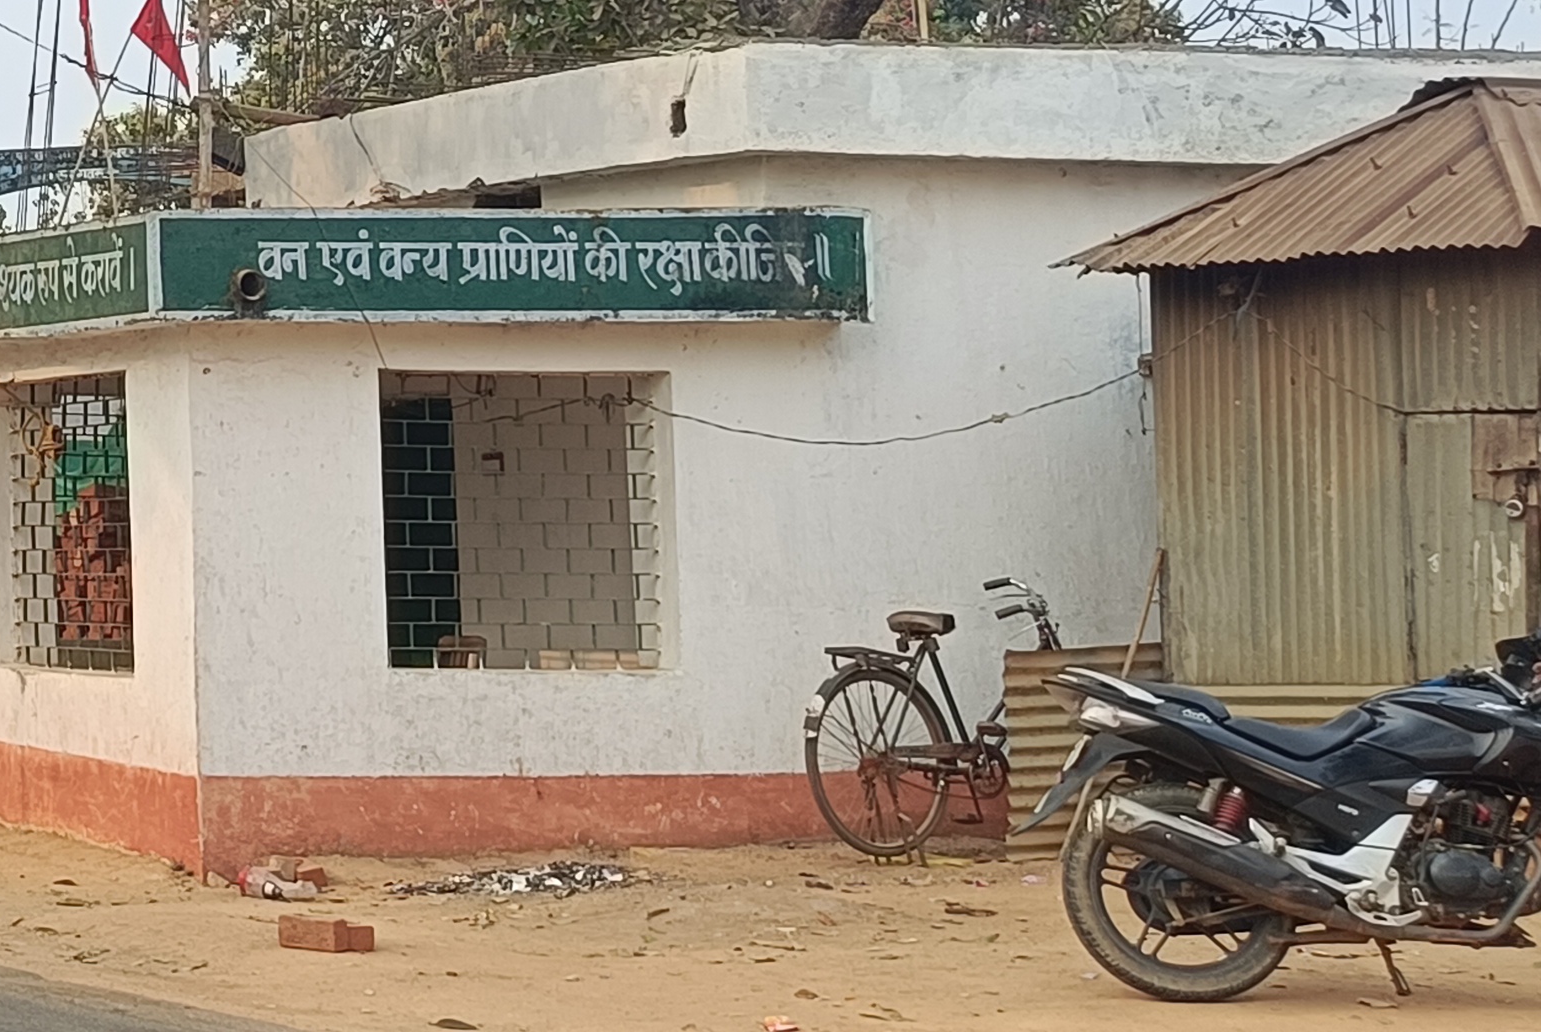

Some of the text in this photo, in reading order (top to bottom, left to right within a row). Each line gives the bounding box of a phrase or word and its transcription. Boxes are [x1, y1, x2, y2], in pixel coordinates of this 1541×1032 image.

[36, 259, 60, 306] रूप
[62, 235, 79, 304] से
[80, 232, 123, 298] करावें
[258, 241, 310, 281] वन
[316, 228, 373, 286] एवं
[379, 241, 452, 282] वन्य
[457, 225, 579, 286] प्राणियों
[585, 225, 631, 282] की
[635, 240, 701, 296] रक्षा
[705, 222, 807, 287] कीजि
